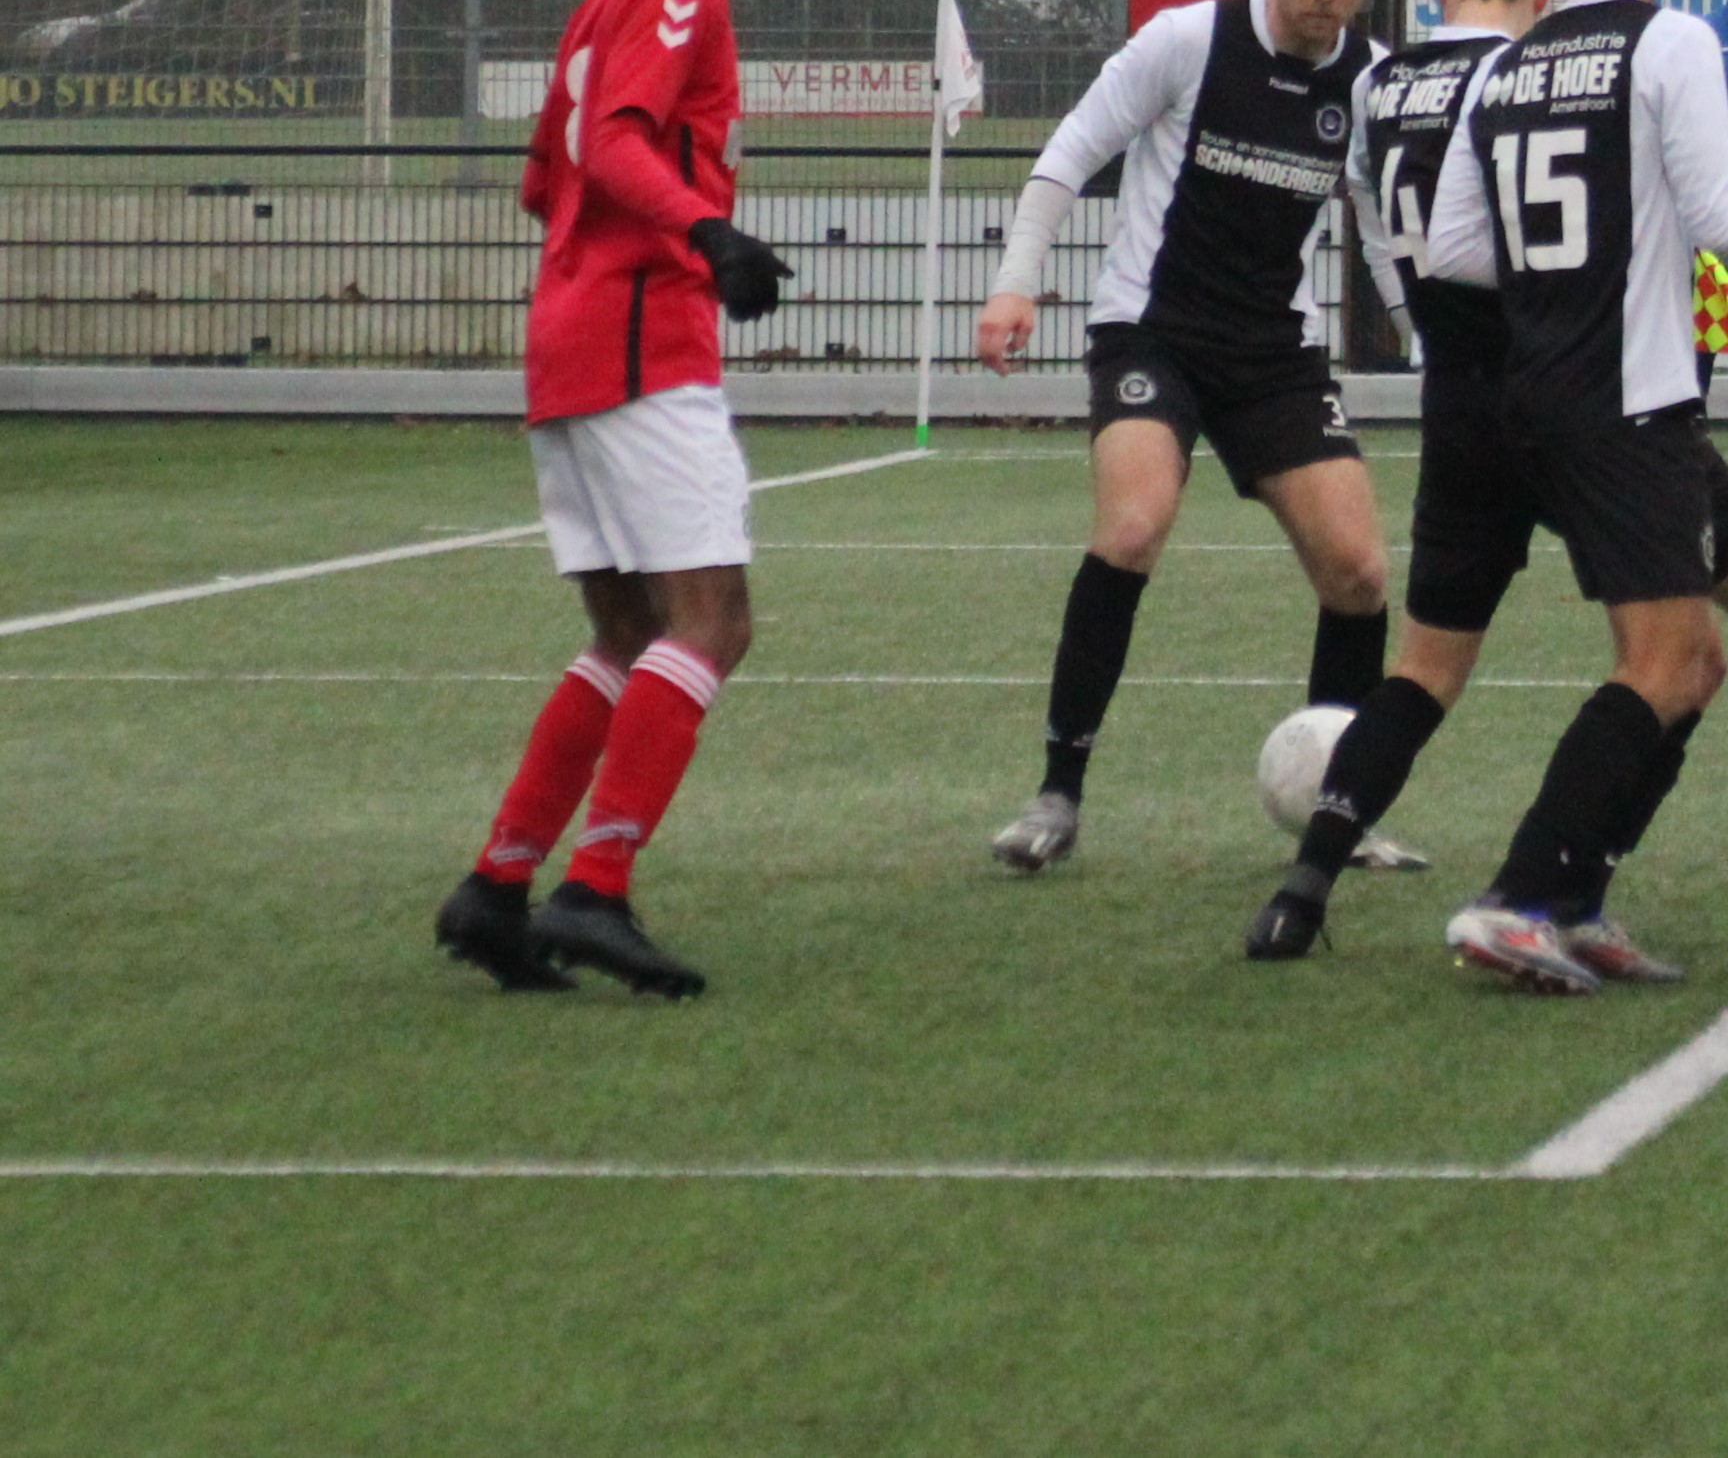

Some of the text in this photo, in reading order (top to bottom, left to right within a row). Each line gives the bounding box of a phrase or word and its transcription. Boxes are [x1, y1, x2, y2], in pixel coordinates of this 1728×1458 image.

[1520, 32, 1627, 62] Houtindustrie
[55, 74, 322, 109] STEIGERS.NL
[1376, 76, 1461, 121] DE HOEF
[1512, 54, 1622, 105] DE HOEF
[1549, 98, 1617, 115] Amersfoort
[1491, 128, 1588, 272] 15
